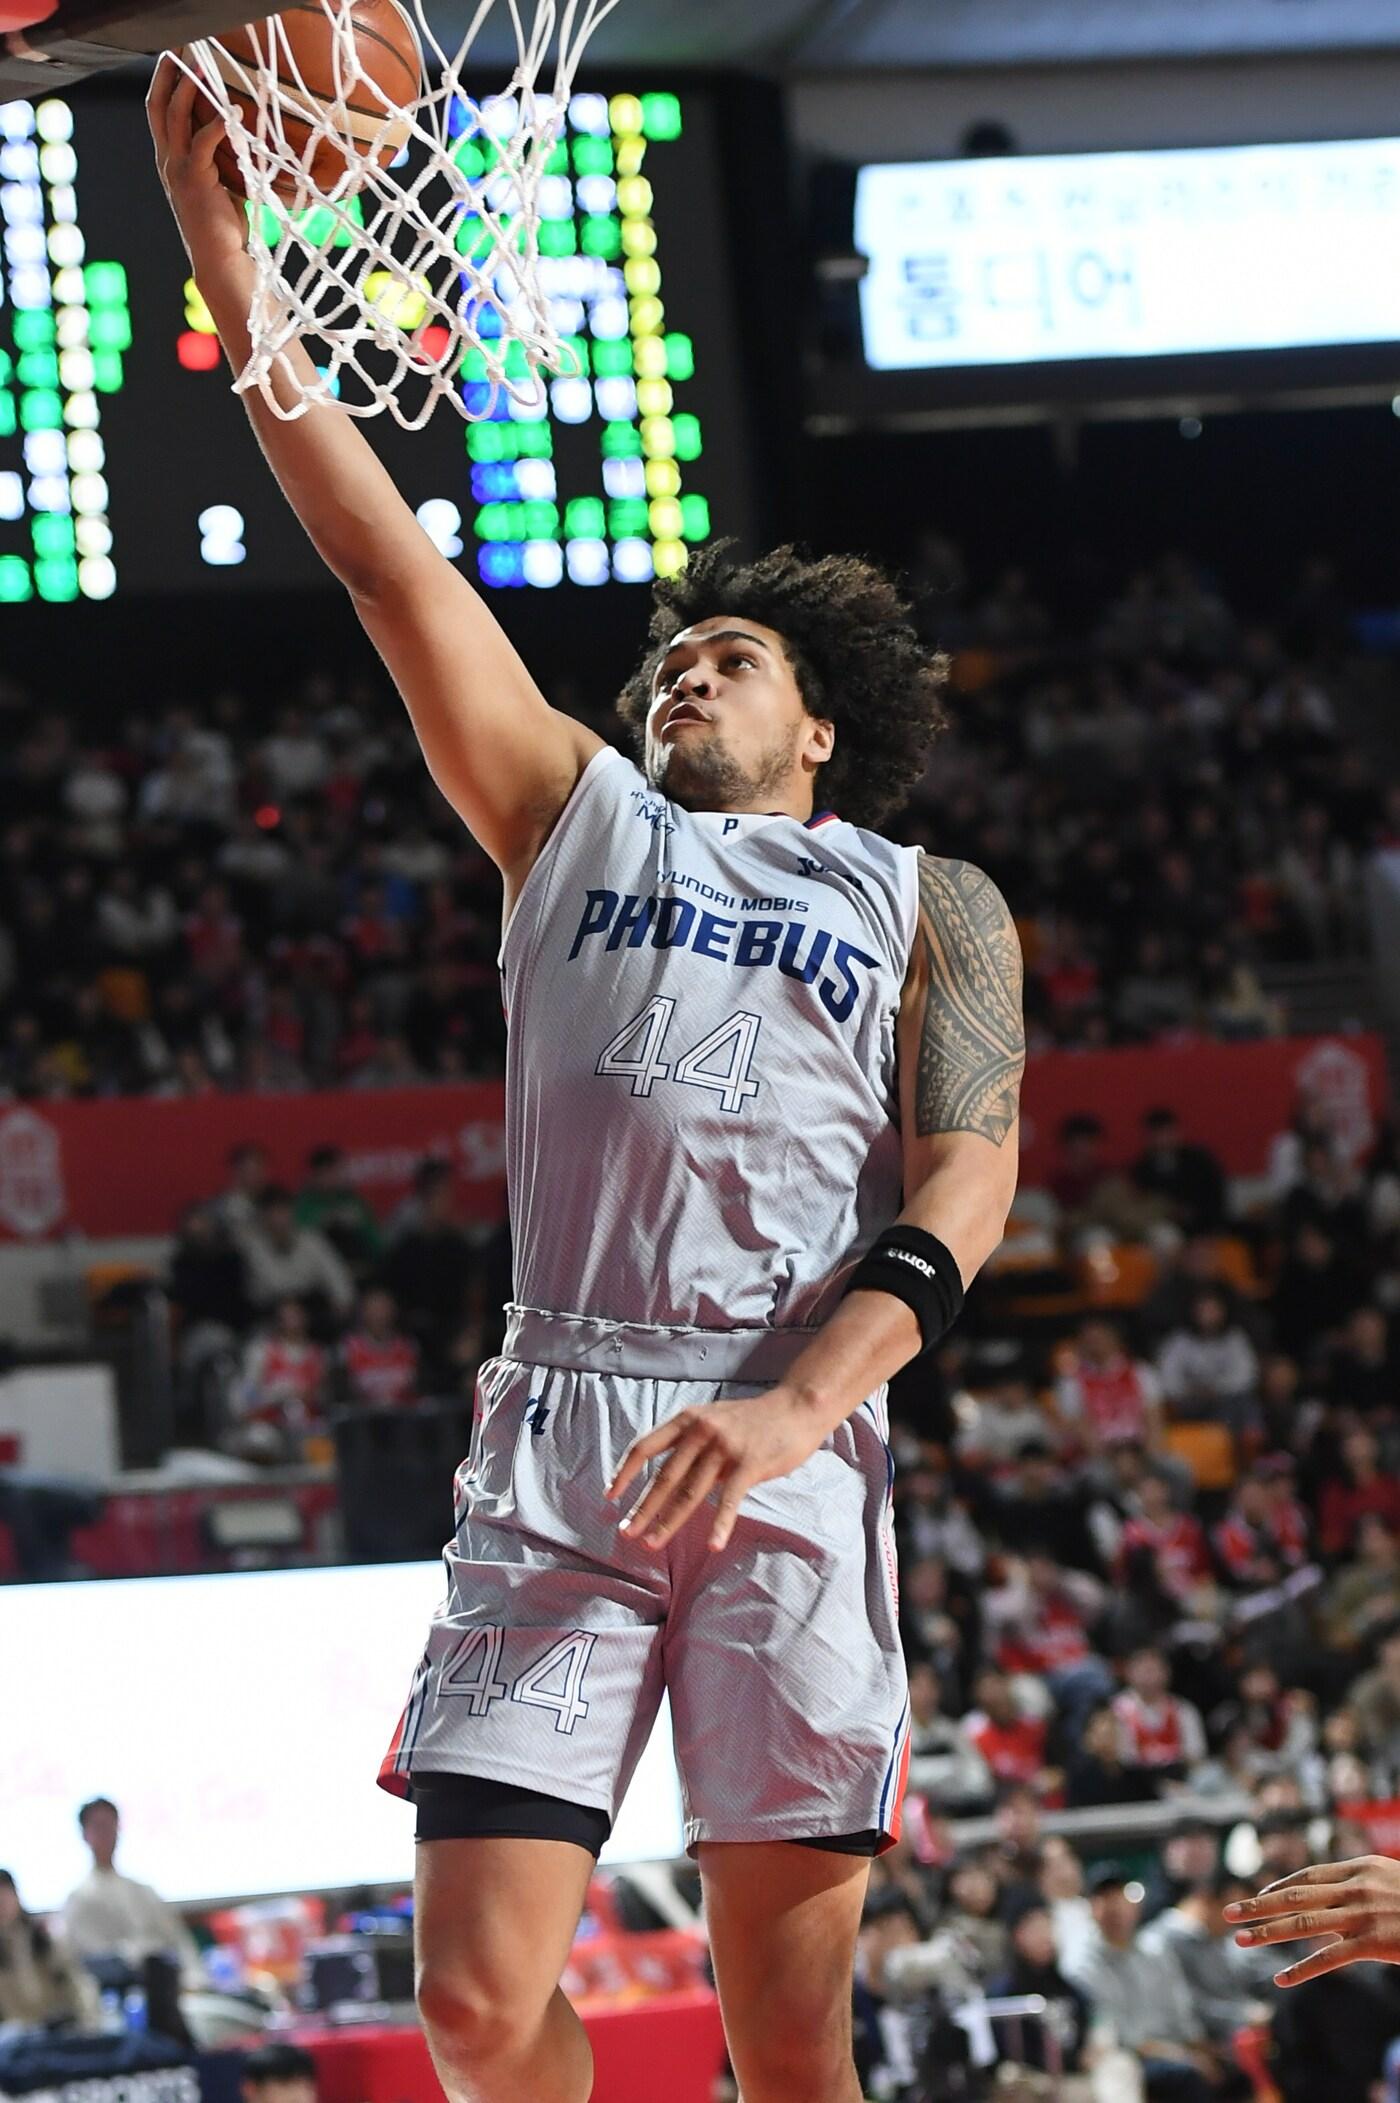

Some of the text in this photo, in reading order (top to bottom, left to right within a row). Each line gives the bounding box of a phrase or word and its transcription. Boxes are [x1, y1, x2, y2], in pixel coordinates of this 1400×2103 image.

[722, 817, 739, 836] P
[567, 888, 882, 1024] PHOEBUS
[740, 896, 810, 913] MOBIS
[594, 994, 762, 1114] 44
[437, 1622, 600, 1736] 44
